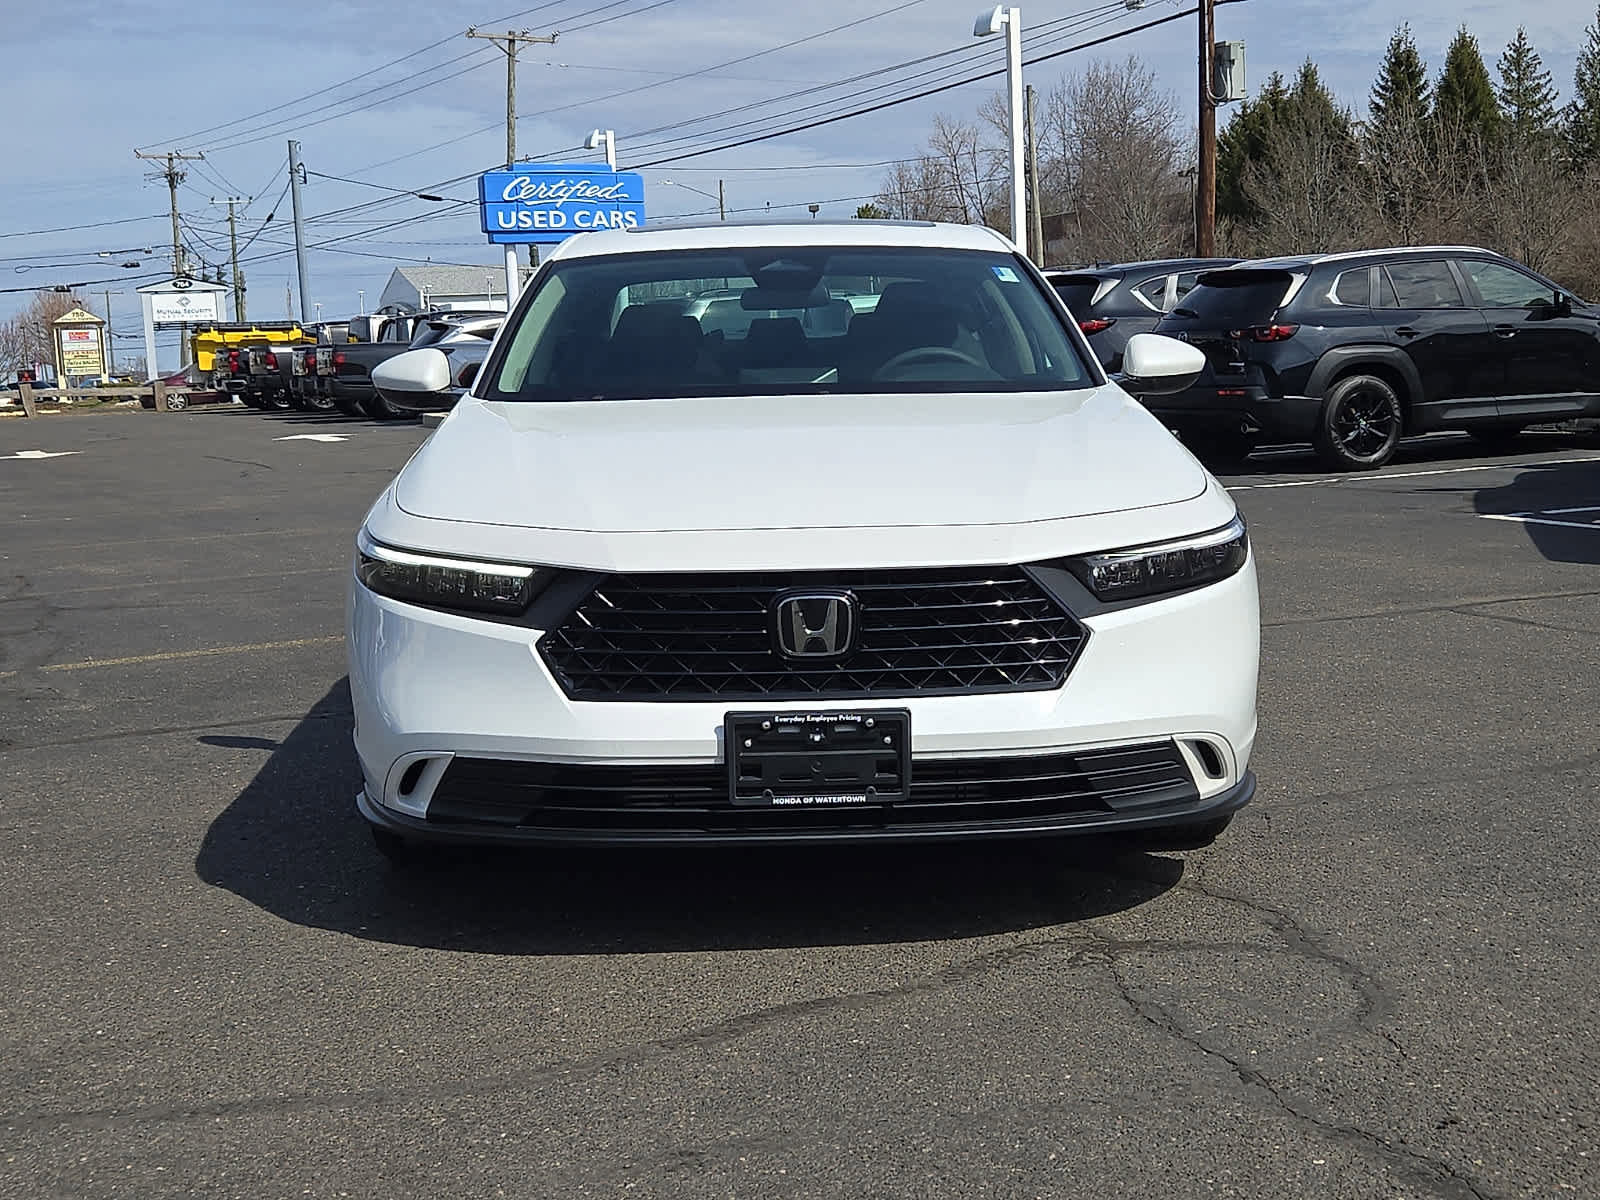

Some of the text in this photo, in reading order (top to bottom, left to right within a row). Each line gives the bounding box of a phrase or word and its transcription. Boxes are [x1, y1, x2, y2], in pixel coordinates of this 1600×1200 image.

[502, 176, 630, 209] Certified
[498, 210, 638, 230] USED CARS
[774, 714, 862, 724] Everyday Employee Pricing
[772, 797, 802, 805] HONDA
[815, 795, 866, 804] WATERTOWN
